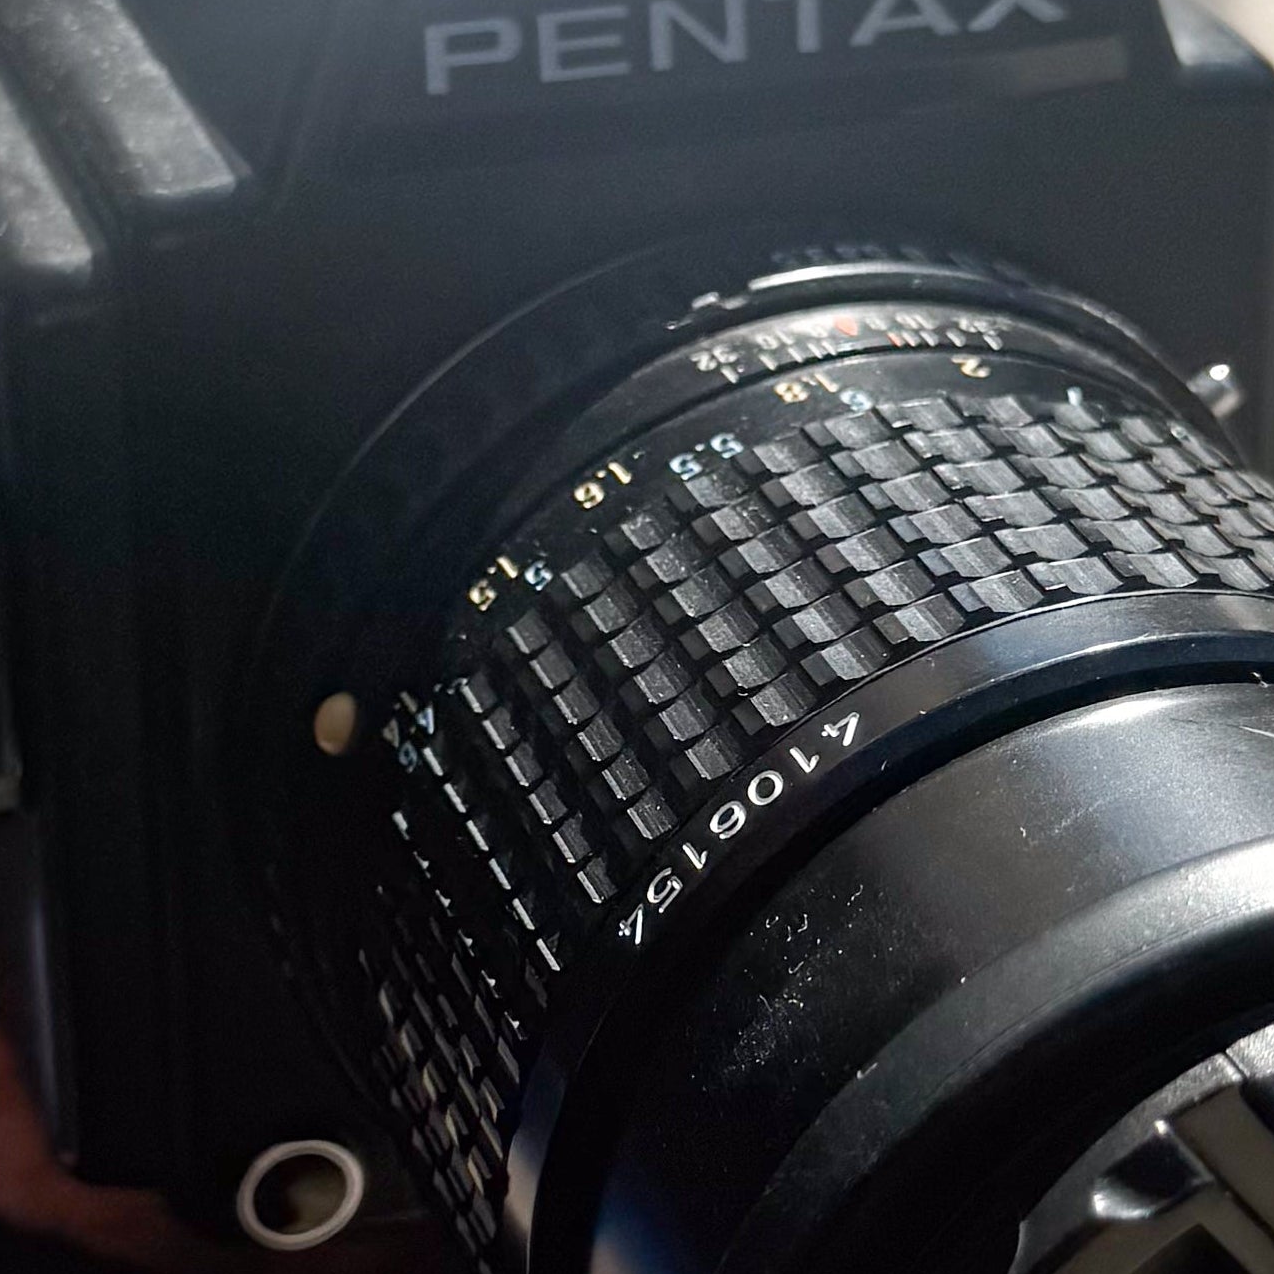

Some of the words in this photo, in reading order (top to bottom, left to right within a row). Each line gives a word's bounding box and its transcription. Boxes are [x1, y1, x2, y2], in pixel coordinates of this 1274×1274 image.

[690, 343, 738, 373] 32
[951, 353, 991, 379] 2
[774, 373, 839, 404] 1.8
[669, 432, 745, 481] 5.5
[573, 461, 632, 510] 1.6
[468, 555, 520, 613] 1.5
[524, 560, 554, 592] 5
[618, 711, 860, 946] 4106154
